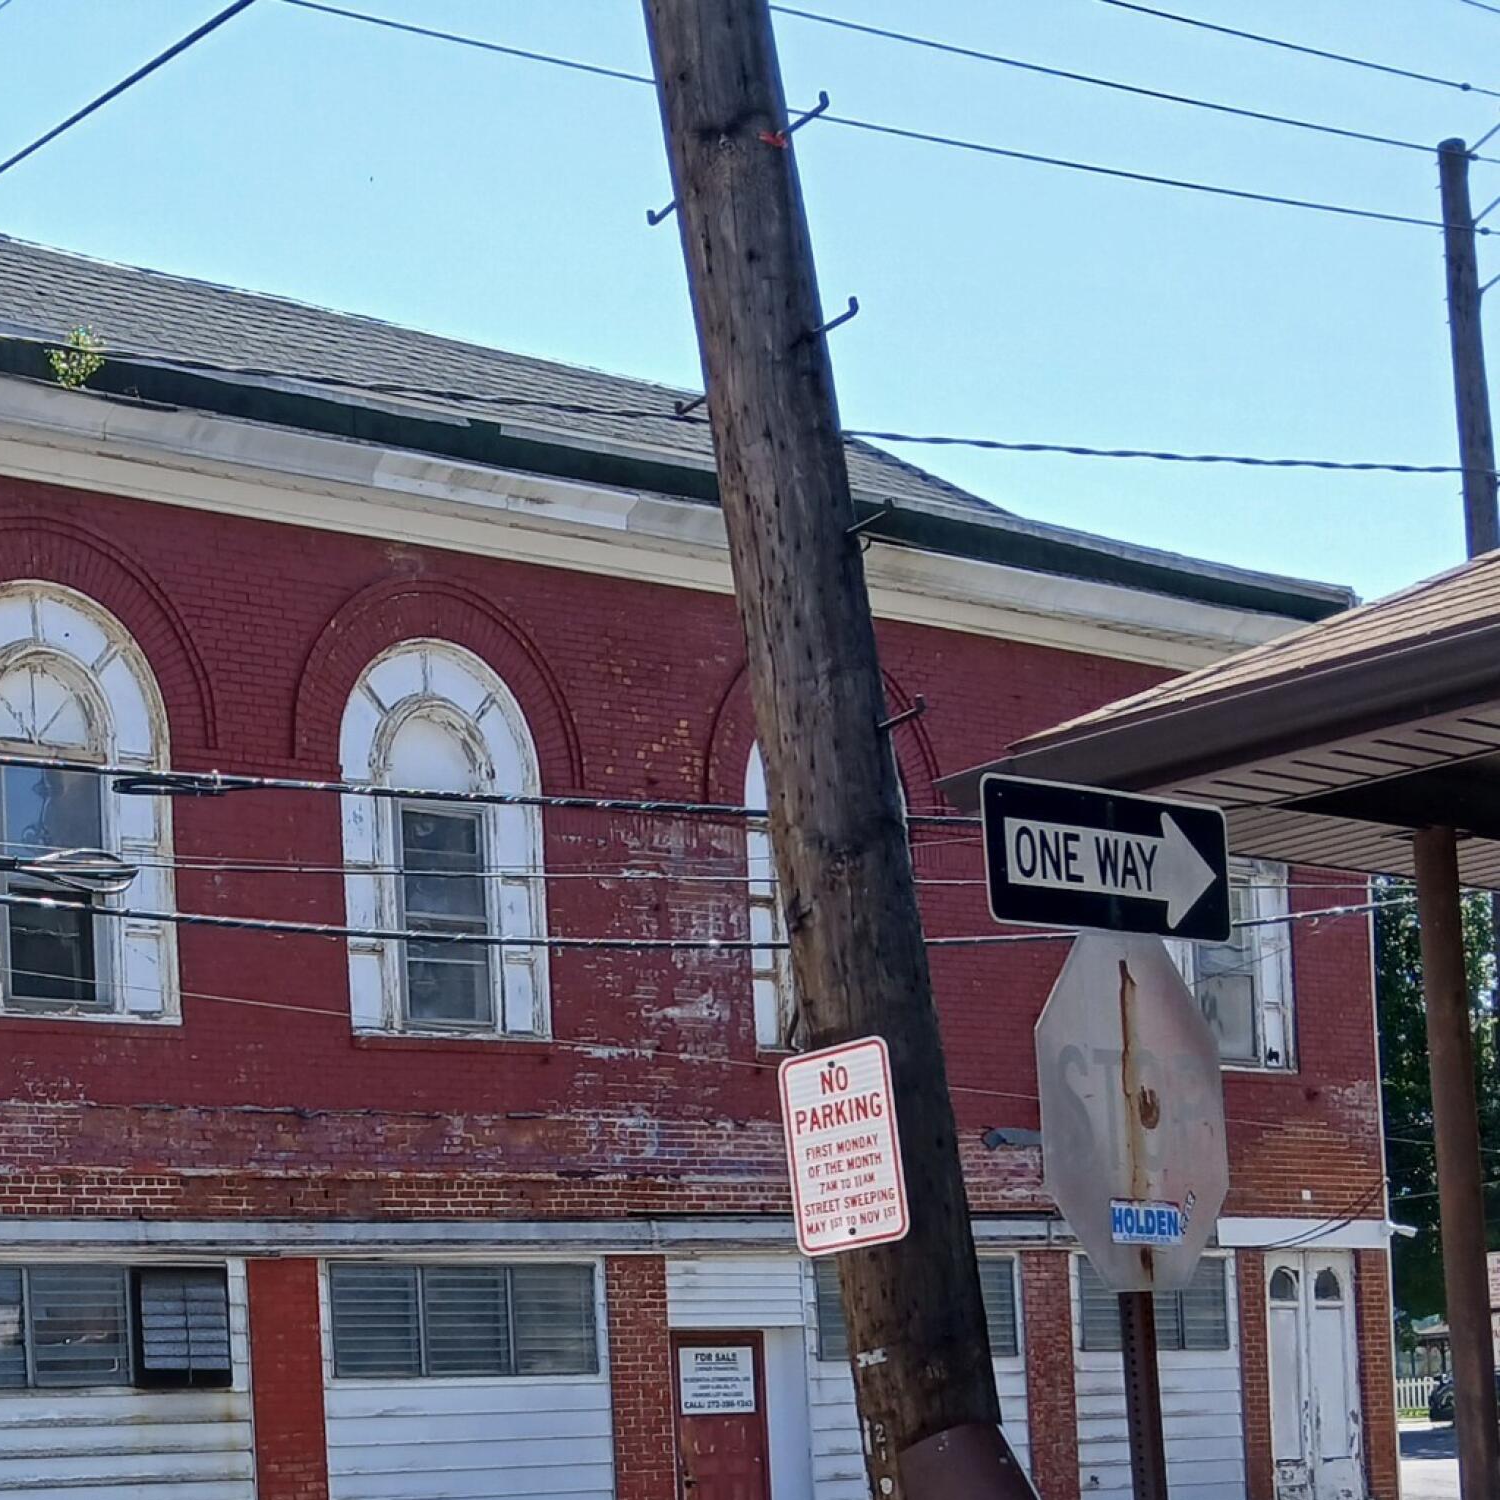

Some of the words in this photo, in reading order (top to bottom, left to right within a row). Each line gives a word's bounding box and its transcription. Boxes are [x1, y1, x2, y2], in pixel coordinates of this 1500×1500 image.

[1014, 825, 1085, 884] ONE
[1094, 835, 1158, 892] WAY
[820, 1066, 848, 1095] NO
[795, 1092, 883, 1135] PARKING
[806, 1143, 832, 1160] FIRST
[836, 1132, 878, 1153] MONDAY
[808, 1164, 821, 1178] OF
[824, 1160, 844, 1175] THE
[846, 1151, 882, 1170] MONTH
[819, 1180, 838, 1195] 7AM
[841, 1178, 851, 1189] TO
[854, 1172, 875, 1187] 11AM
[804, 1198, 840, 1216] STREET
[844, 1187, 896, 1209] SWEEPING
[806, 1220, 826, 1235] MAY
[830, 1217, 843, 1231] 1ST
[846, 1215, 857, 1226] TO
[860, 1209, 880, 1224] NOV
[884, 1206, 896, 1220] 1ST
[1112, 1207, 1179, 1236] HOLDEN
[694, 1352, 713, 1361] FOR
[715, 1352, 738, 1361] SALE
